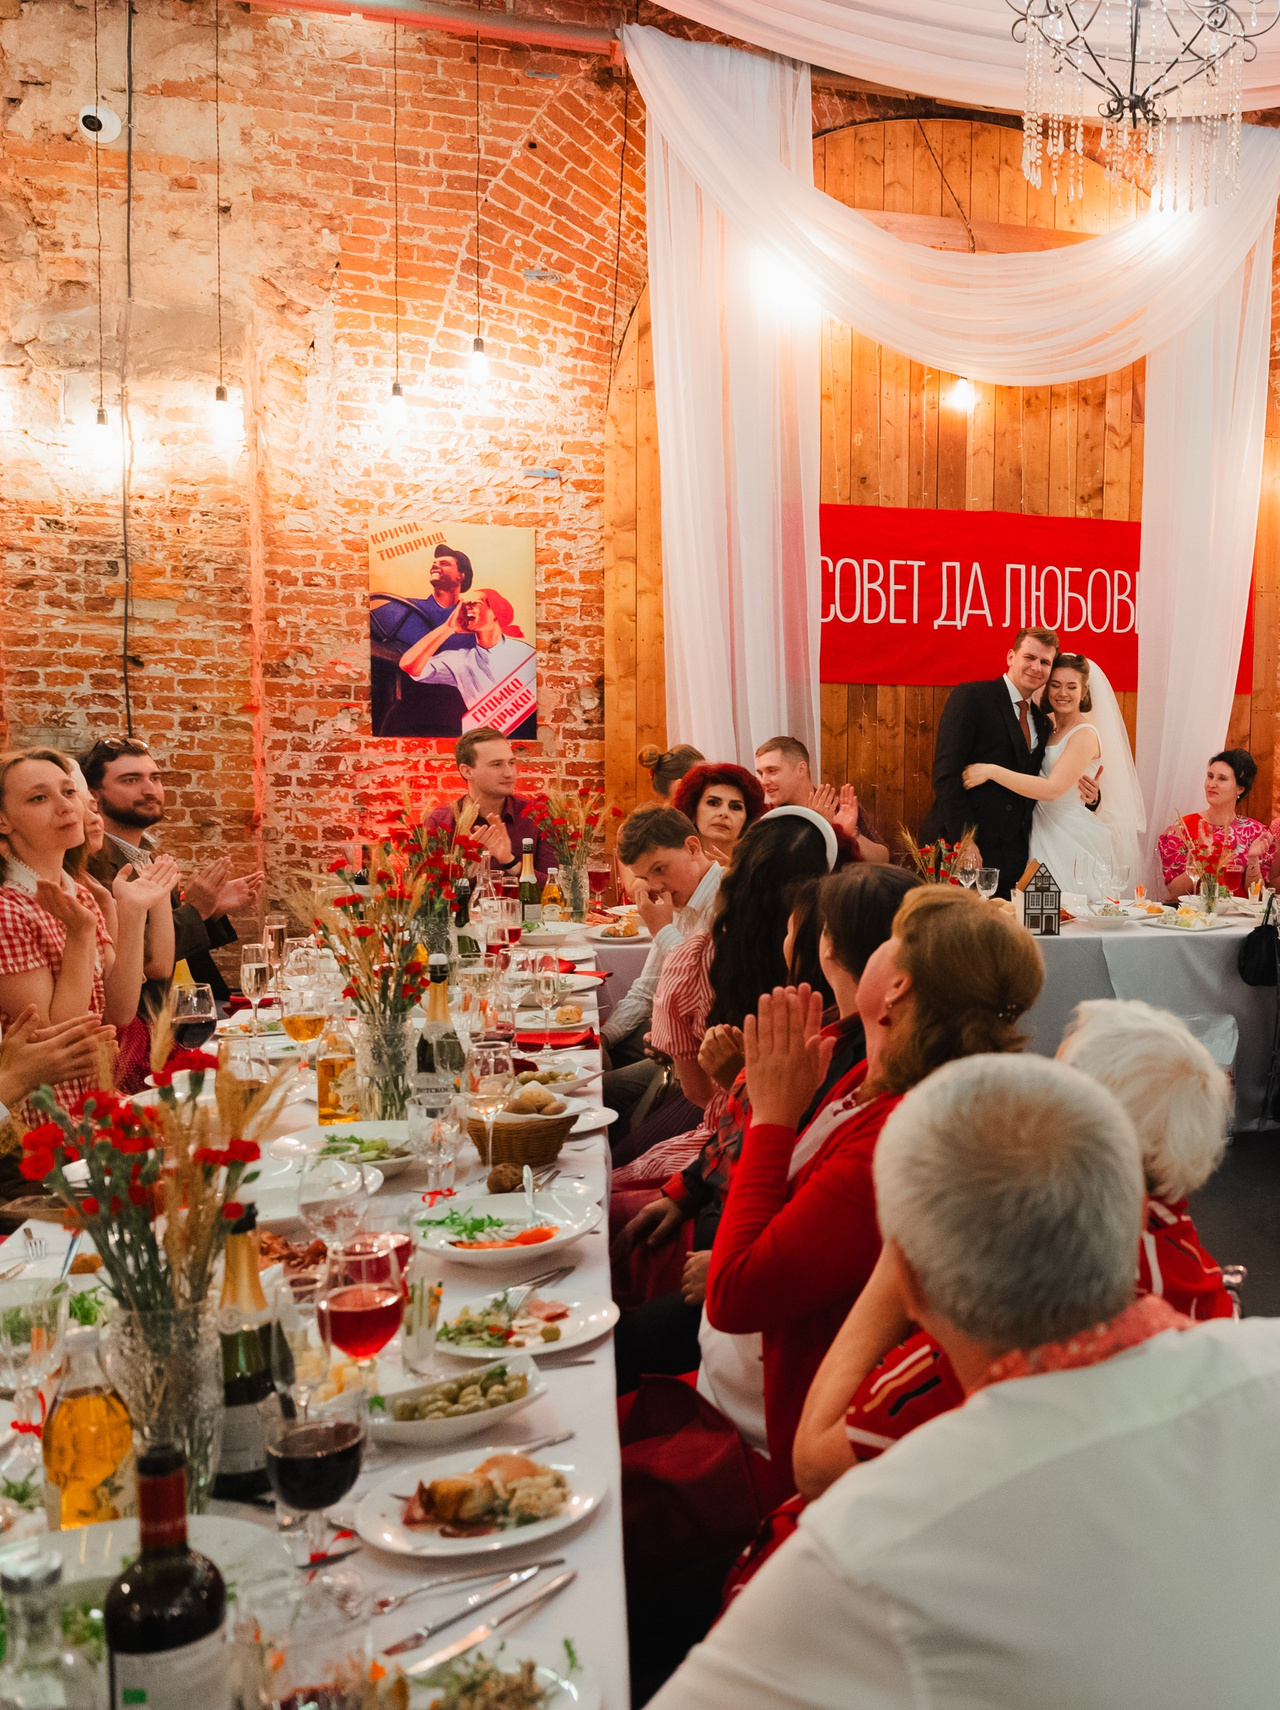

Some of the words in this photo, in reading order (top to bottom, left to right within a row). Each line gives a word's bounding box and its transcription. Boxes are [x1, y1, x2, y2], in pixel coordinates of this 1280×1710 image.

[370, 522, 424, 545] КРИЧИ,
[376, 531, 448, 561] ТОВАРИЩ
[933, 561, 993, 630] ДА
[1002, 563, 1140, 635] ЛЮБОВ
[471, 678, 523, 723] ГРОМКО
[488, 689, 535, 730] ОРЬКО!
